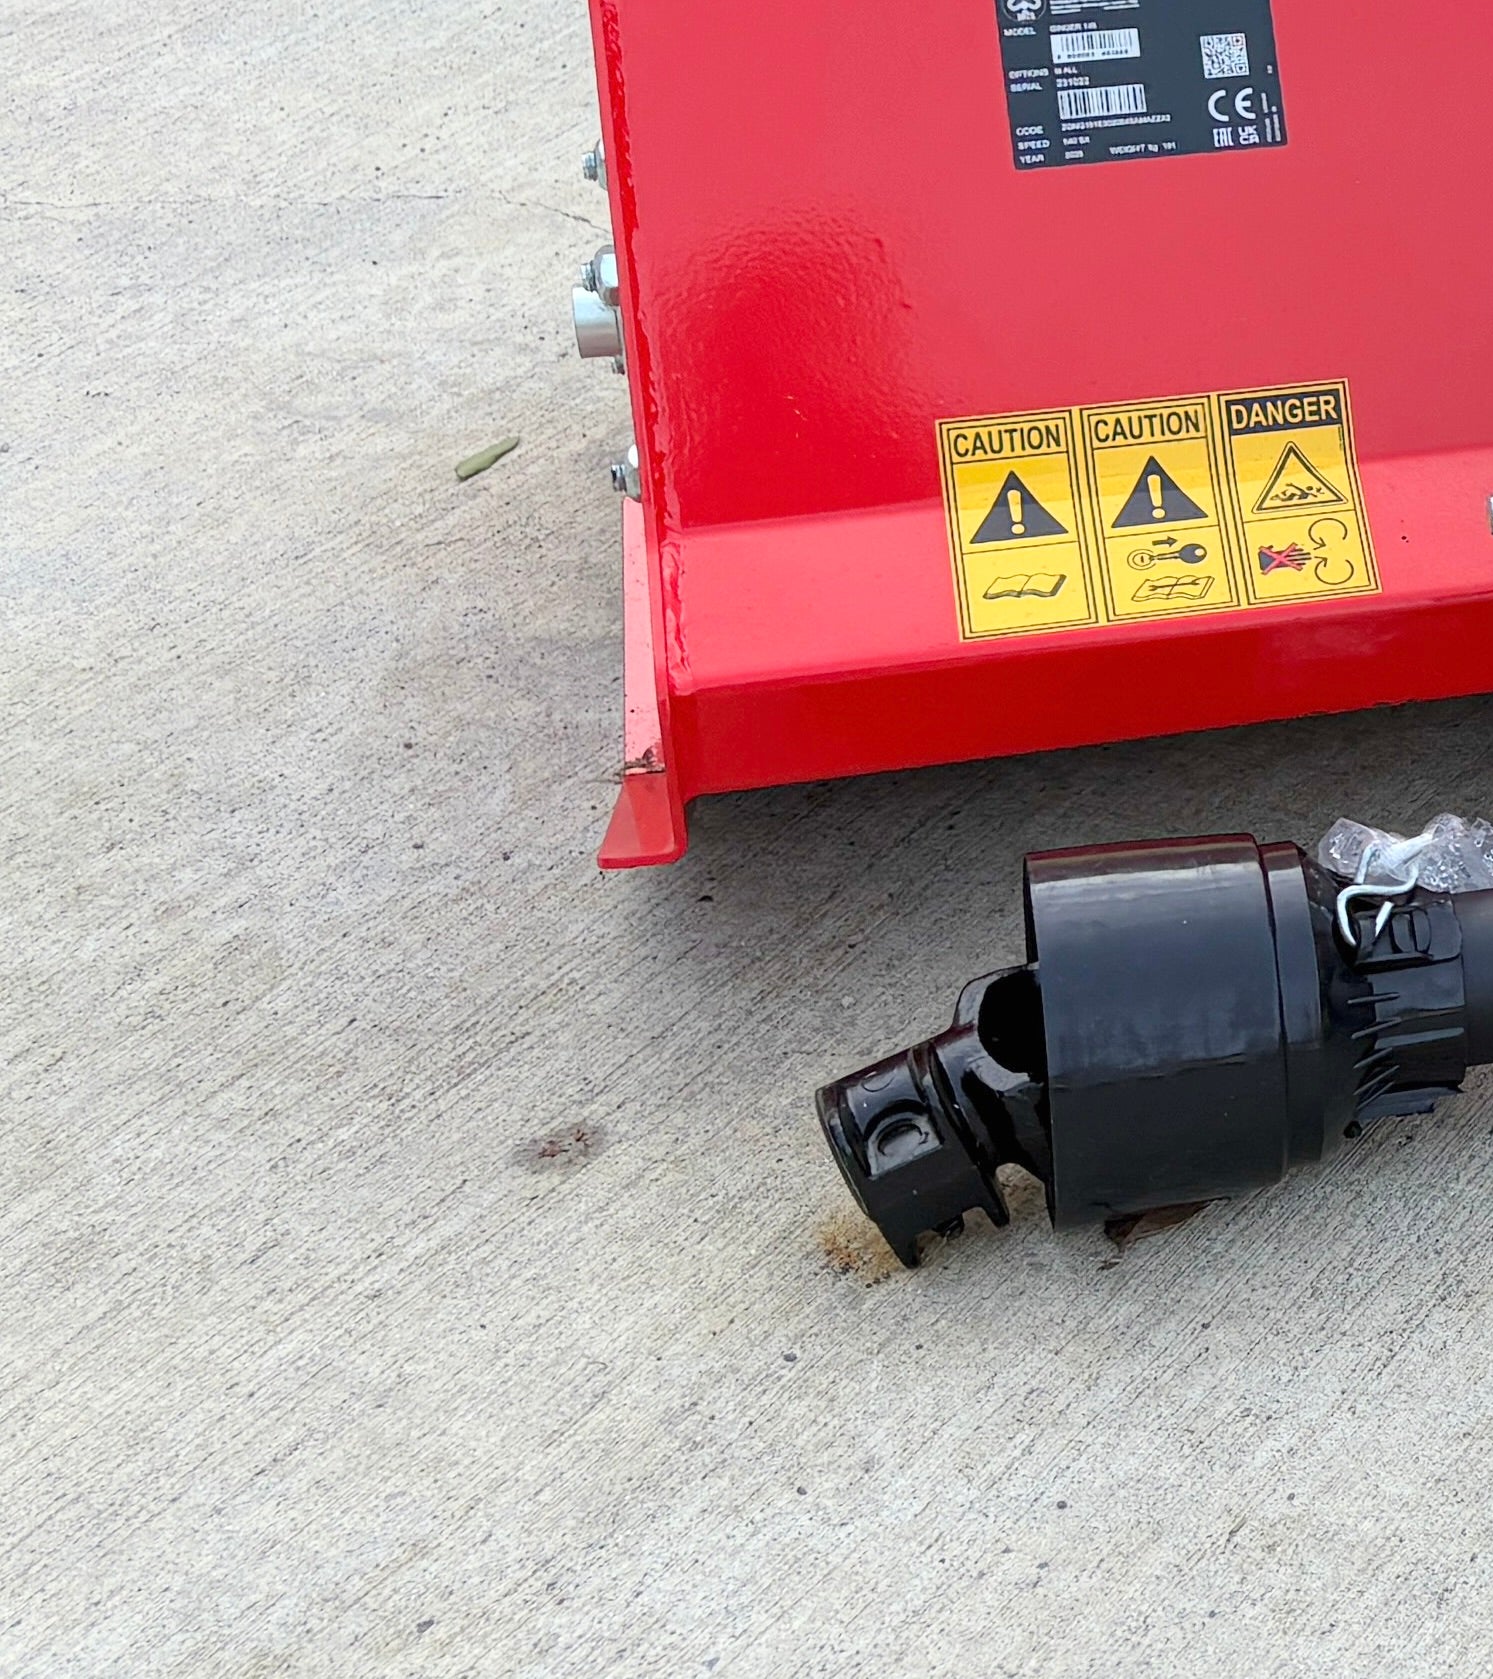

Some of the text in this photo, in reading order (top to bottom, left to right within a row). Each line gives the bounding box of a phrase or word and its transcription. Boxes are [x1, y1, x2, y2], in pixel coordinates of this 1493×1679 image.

[1004, 27, 1036, 36] MODEL
[1016, 126, 1044, 136] CODE
[1018, 140, 1050, 150] SPEED
[1020, 155, 1045, 164] YEAR
[1230, 395, 1338, 431] DANGER
[1094, 411, 1200, 443] CAUTION
[953, 424, 1062, 458] CAUTION
